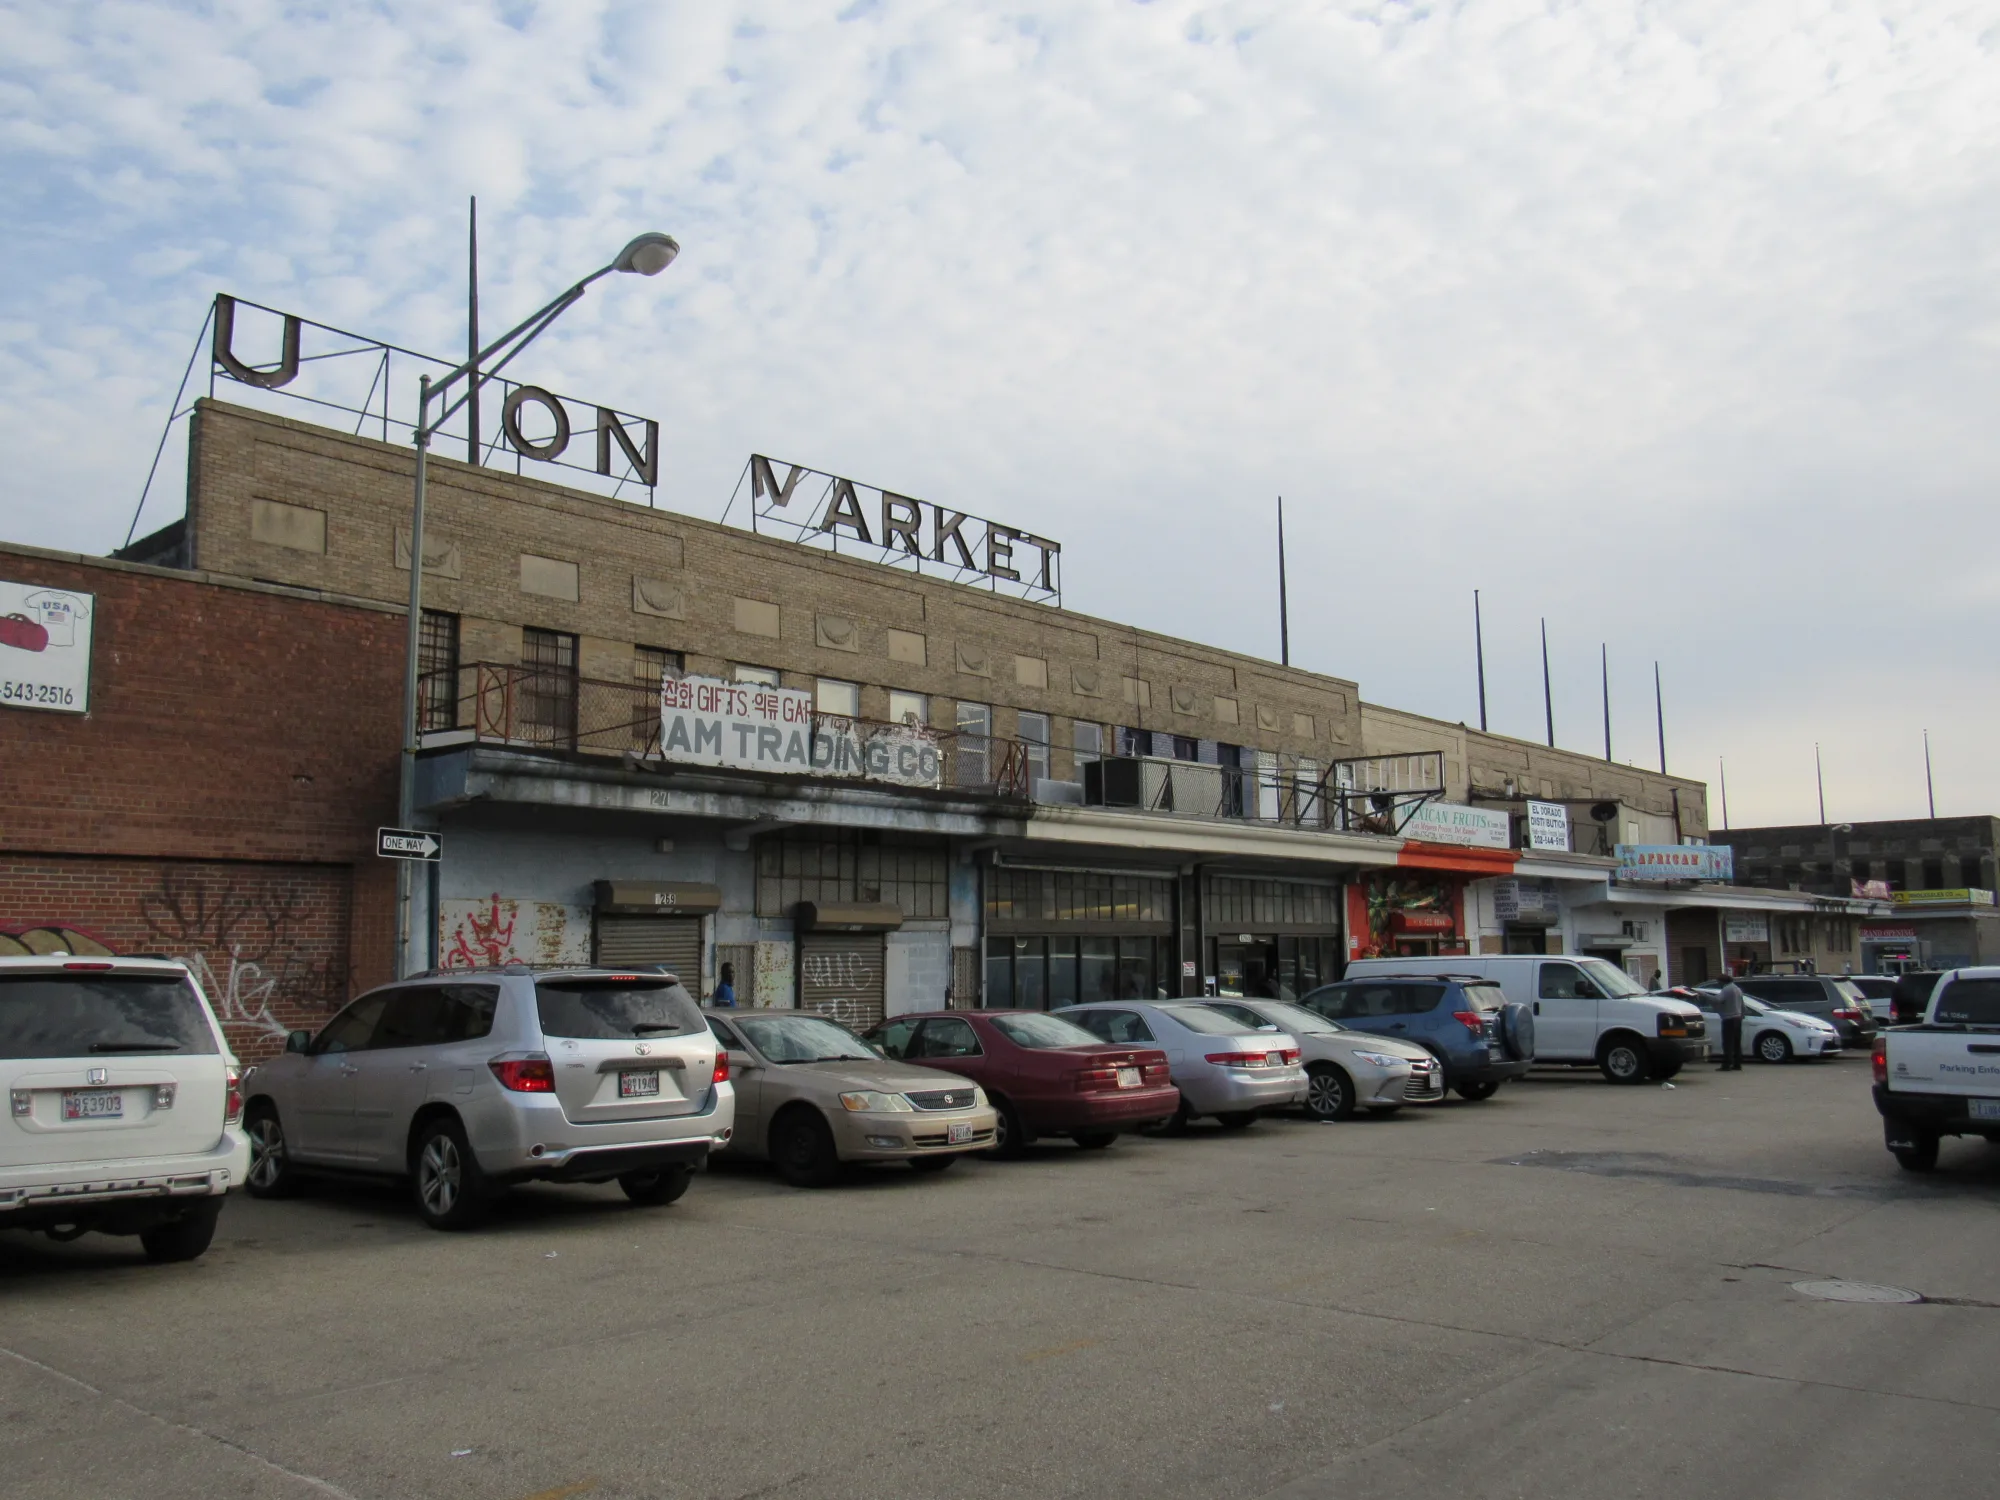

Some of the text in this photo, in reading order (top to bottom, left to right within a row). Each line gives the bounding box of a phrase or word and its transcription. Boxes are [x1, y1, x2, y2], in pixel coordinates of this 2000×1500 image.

[42, 601, 70, 612] USA
[732, 721, 890, 776] TRADING
[1401, 805, 1448, 825] MEXICAN
[1452, 811, 1487, 829] FRUITS
[1532, 805, 1562, 818] EL DORADO
[386, 837, 424, 851] ONE WAY
[1638, 853, 1699, 866] AFRICAN
[1621, 868, 1638, 878] 1259
[1860, 928, 1915, 938] GRAND OPENING
[1940, 1063, 1976, 1075] Parking
